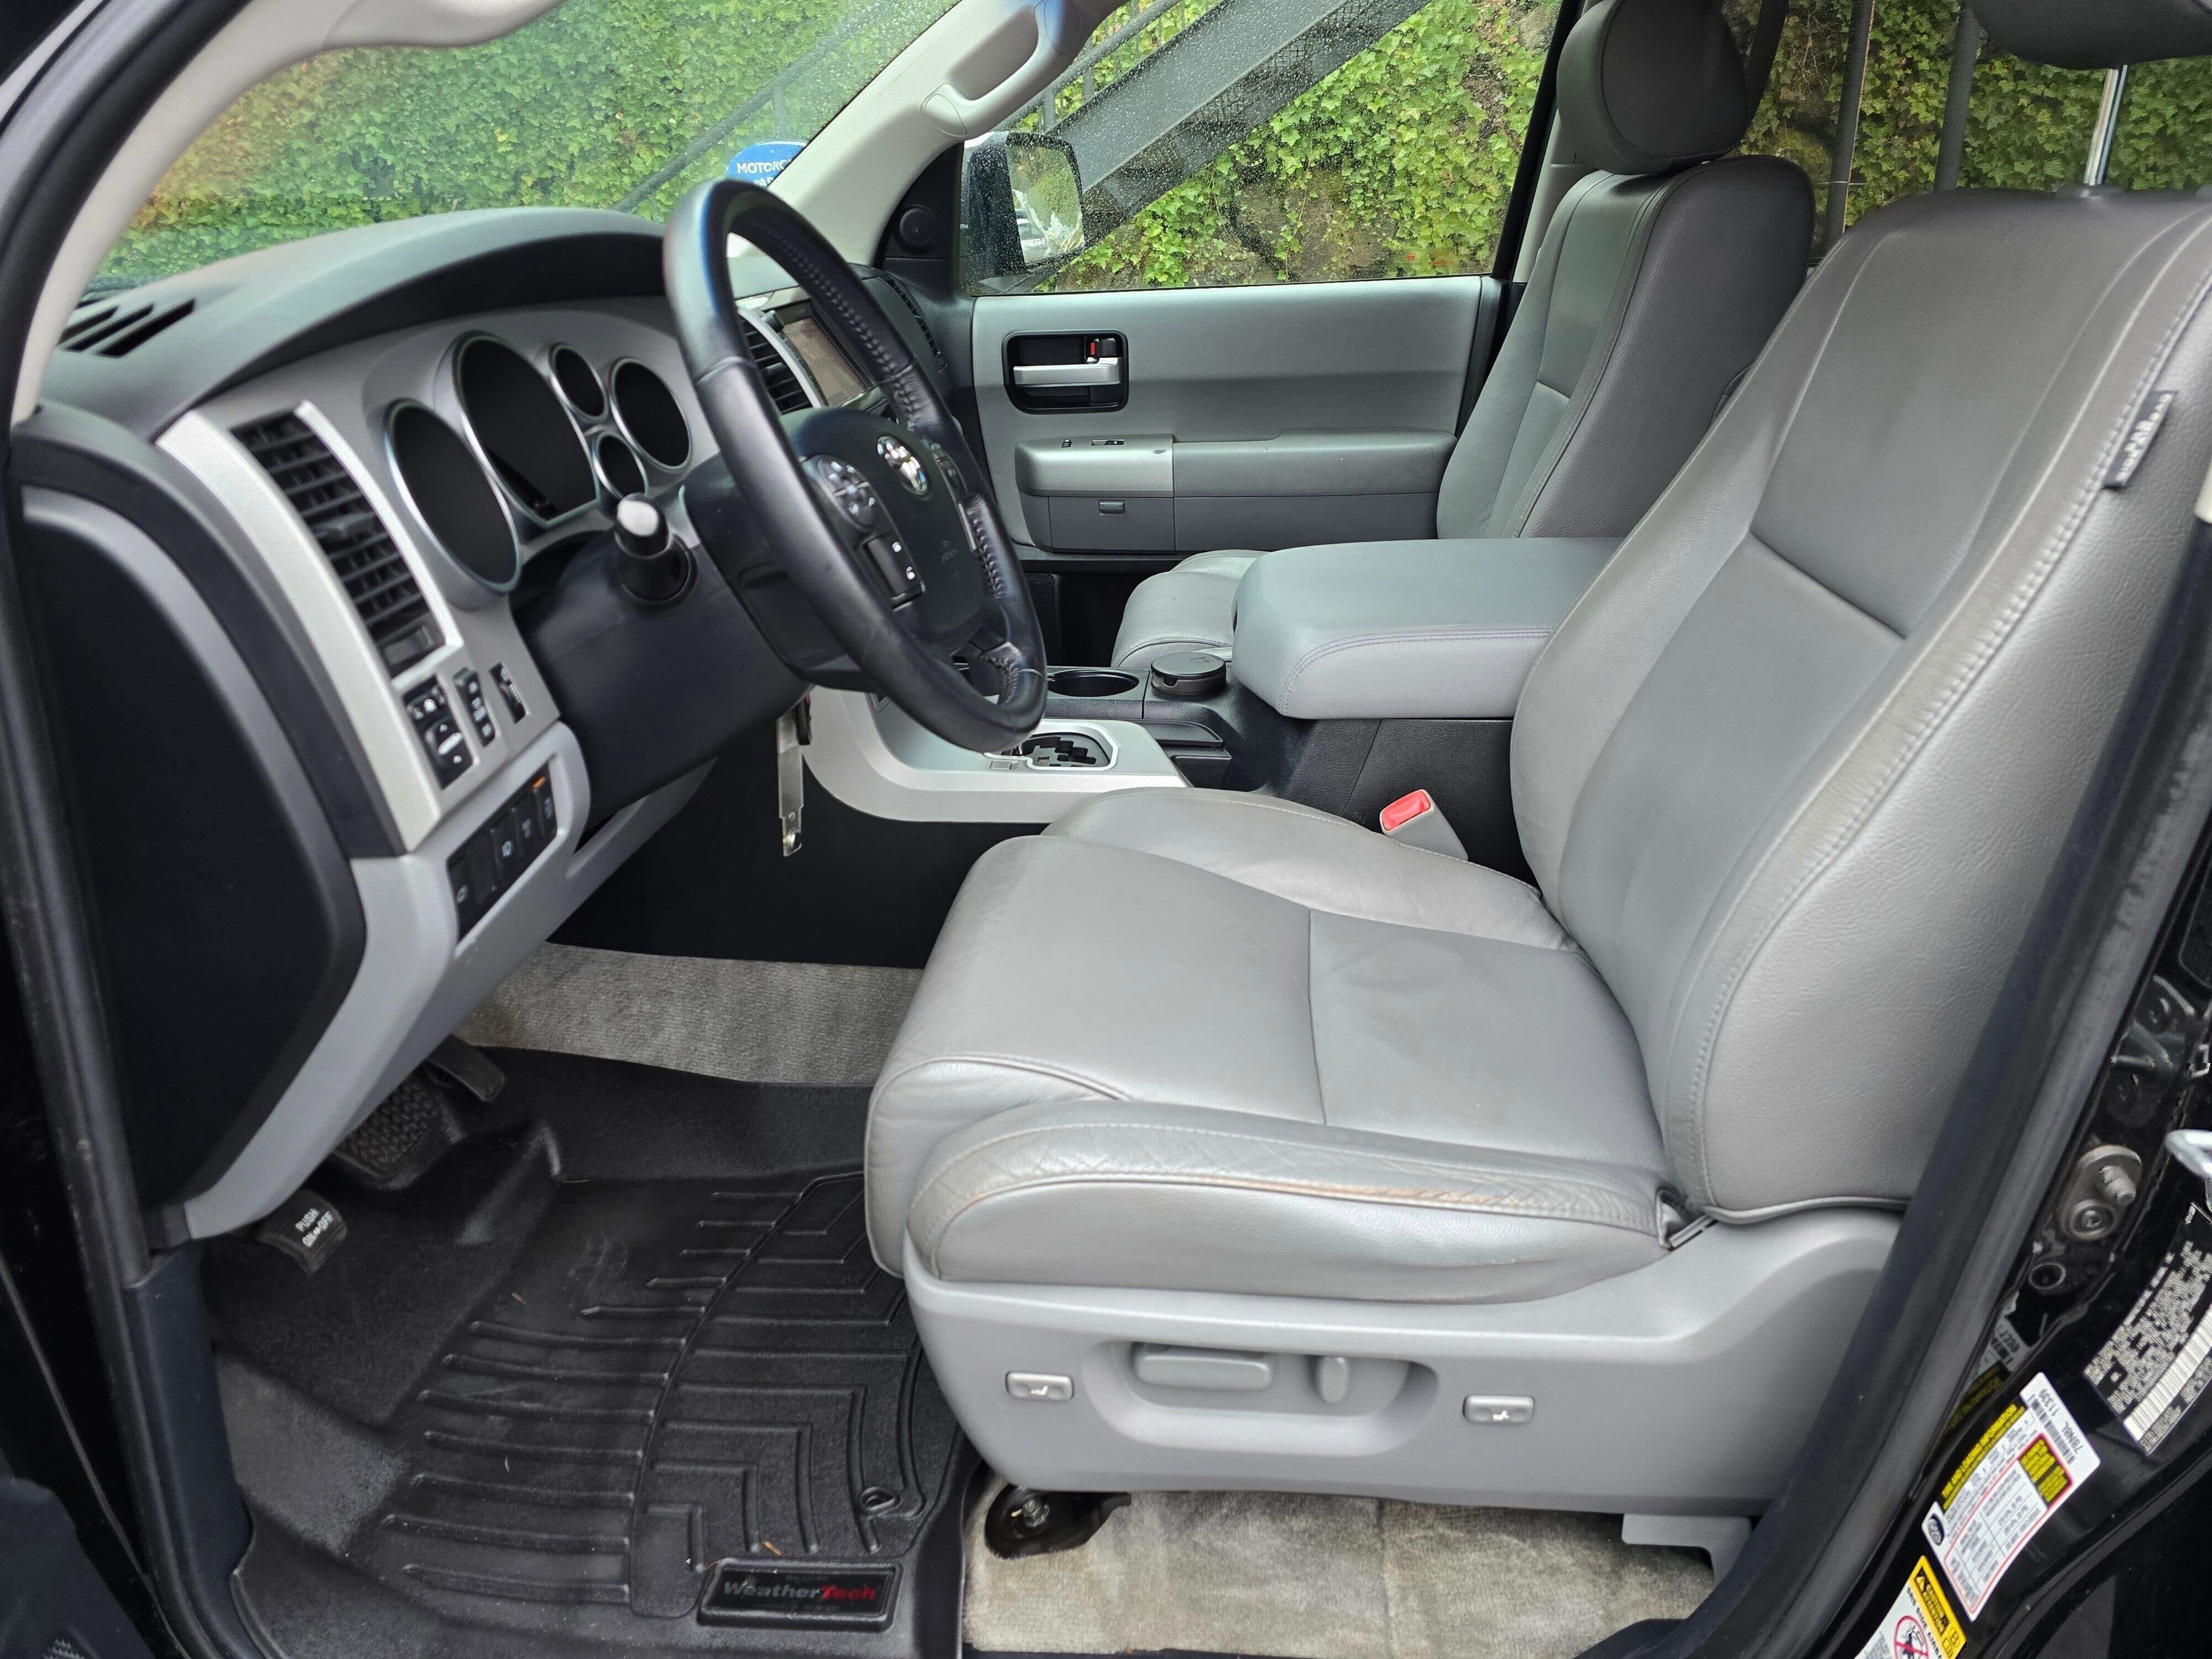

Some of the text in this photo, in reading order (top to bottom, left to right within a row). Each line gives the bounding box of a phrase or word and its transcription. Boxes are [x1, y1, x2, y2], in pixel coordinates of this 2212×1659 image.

[295, 1208, 319, 1232] PUSH
[302, 1210, 333, 1246] ON OFF
[1979, 1403, 2018, 1447] INFORMATION
[724, 1581, 876, 1600] WeatherTech
